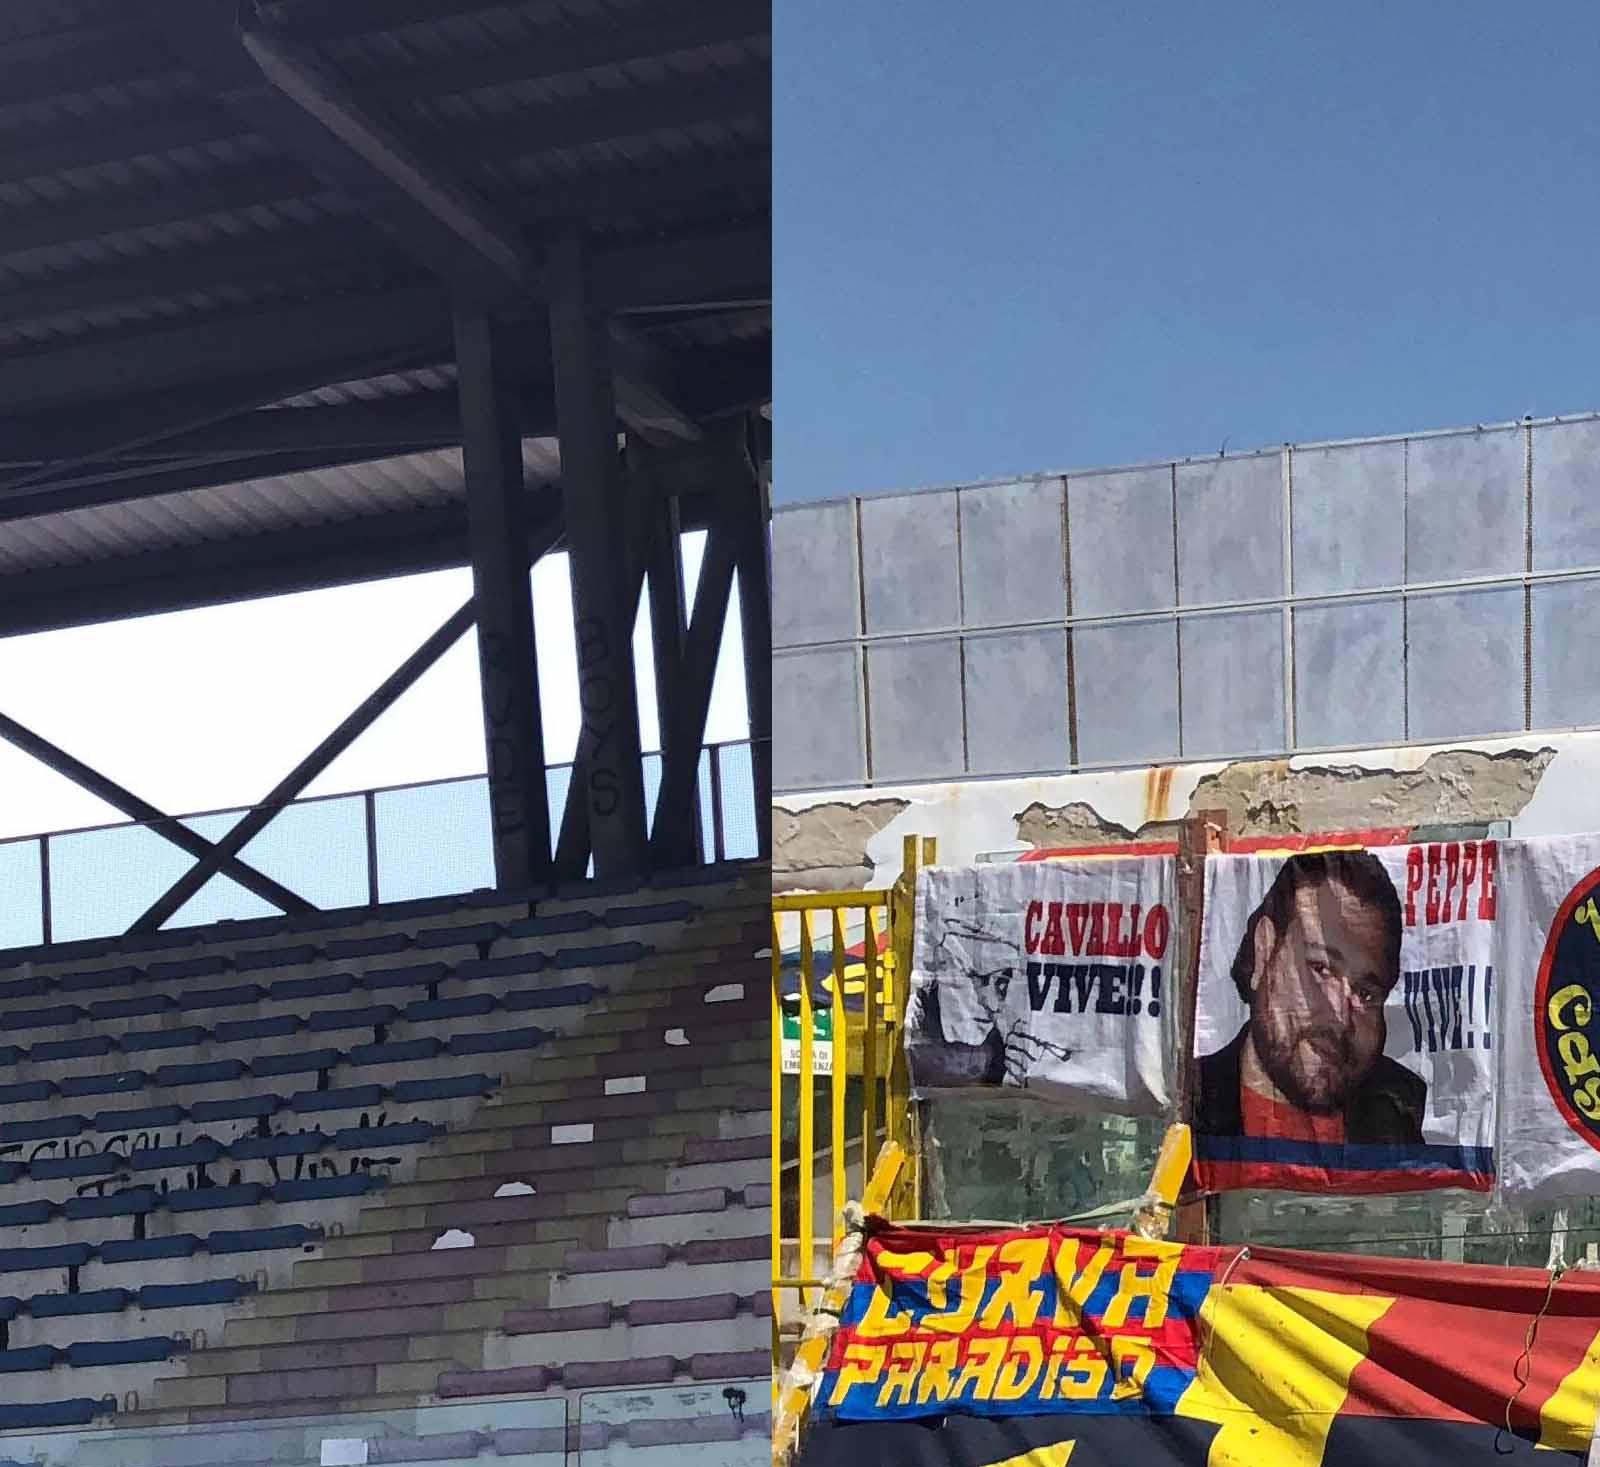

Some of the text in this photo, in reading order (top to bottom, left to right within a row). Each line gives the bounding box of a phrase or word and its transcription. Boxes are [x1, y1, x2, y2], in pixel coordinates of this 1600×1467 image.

[1406, 840, 1497, 926] PEPPE
[1025, 900, 1170, 958] CAVALLO
[1026, 962, 1161, 1017] VIVE!!
[855, 1235, 1190, 1337] CURVA
